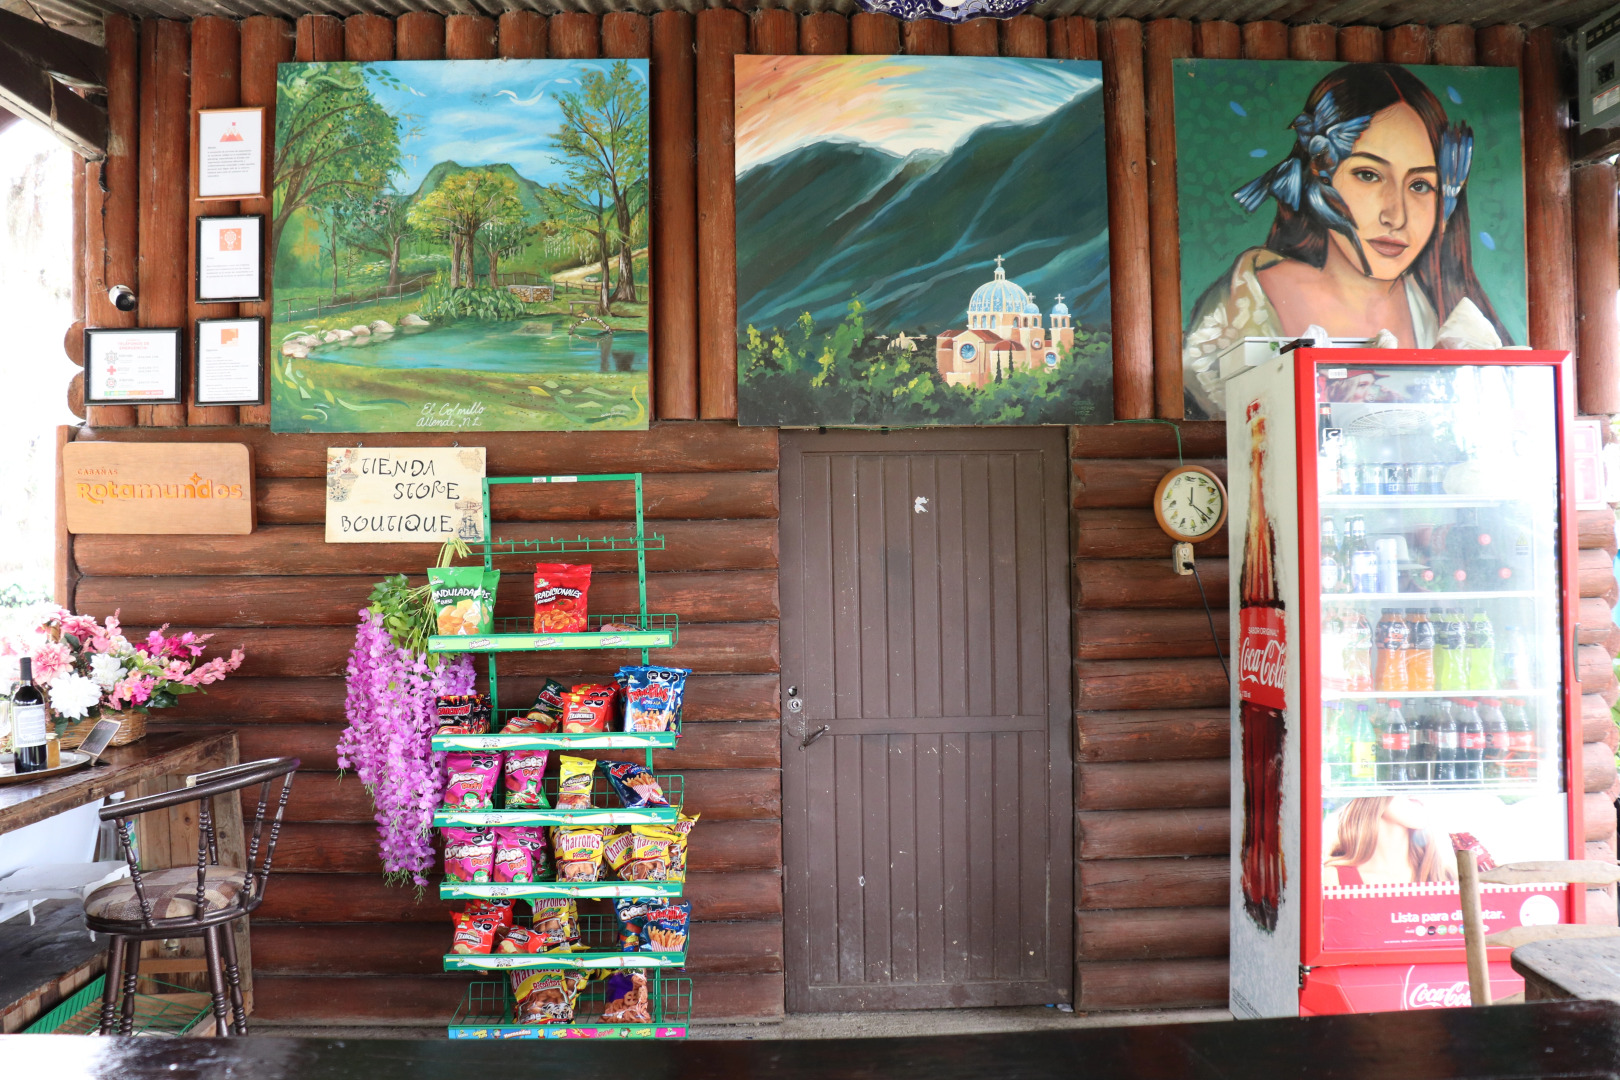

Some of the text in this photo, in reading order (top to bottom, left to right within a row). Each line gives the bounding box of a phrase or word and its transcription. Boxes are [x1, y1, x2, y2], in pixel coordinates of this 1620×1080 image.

[421, 401, 487, 417] El Colmillo
[77, 467, 118, 476] CABAÑAS
[361, 457, 435, 478] TIENDA
[76, 480, 242, 504] Rotamundos
[393, 480, 460, 500] STORE
[341, 514, 454, 533] BOUTIQUE
[432, 587, 481, 600] ONDULADA
[535, 587, 583, 601] TRADICIONALES
[1241, 637, 1286, 689] Coca-Cola
[562, 833, 600, 852] Charrones
[604, 833, 633, 864] Charrone
[535, 898, 567, 913] harrones
[1390, 912, 1419, 924] Lista
[1421, 912, 1449, 924] para
